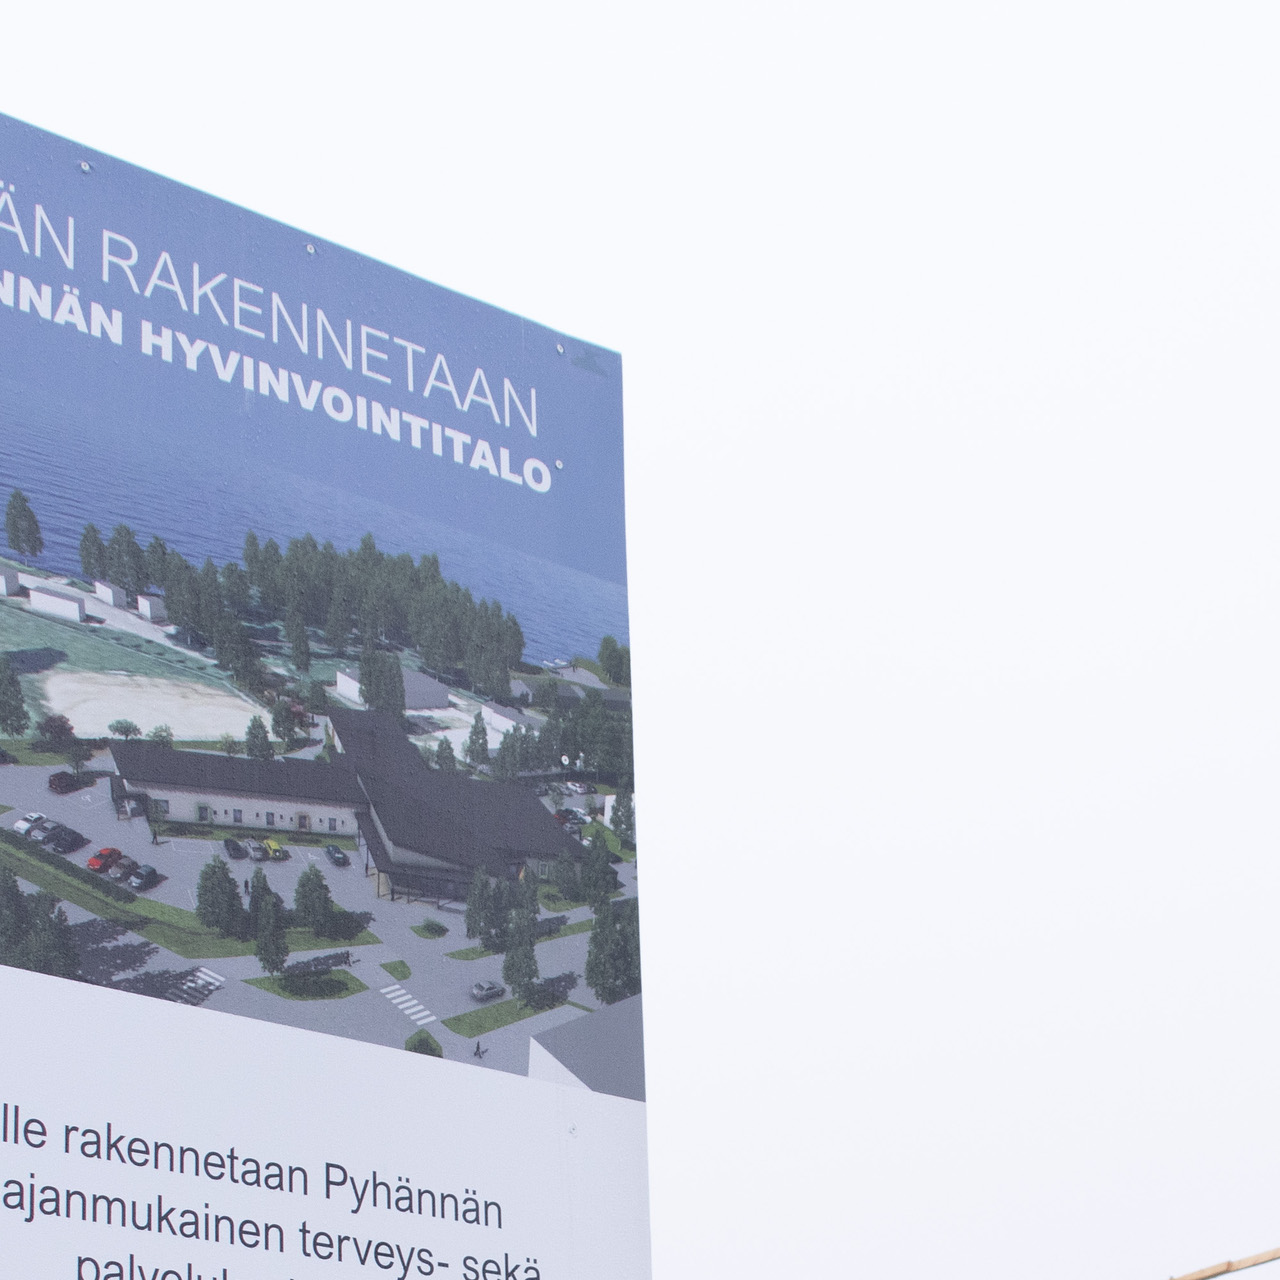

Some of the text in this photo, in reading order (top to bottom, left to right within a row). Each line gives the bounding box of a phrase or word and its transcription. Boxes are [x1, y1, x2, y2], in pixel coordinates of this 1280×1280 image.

[102, 228, 538, 438] RAKENNETAAN
[141, 319, 552, 494] HYVINVOINTITALO
[2, 1174, 285, 1253] ajanmukainen
[298, 1222, 450, 1280] terveys-
[63, 1123, 309, 1196] rakennetaan
[325, 1162, 503, 1230] Pyhännän
